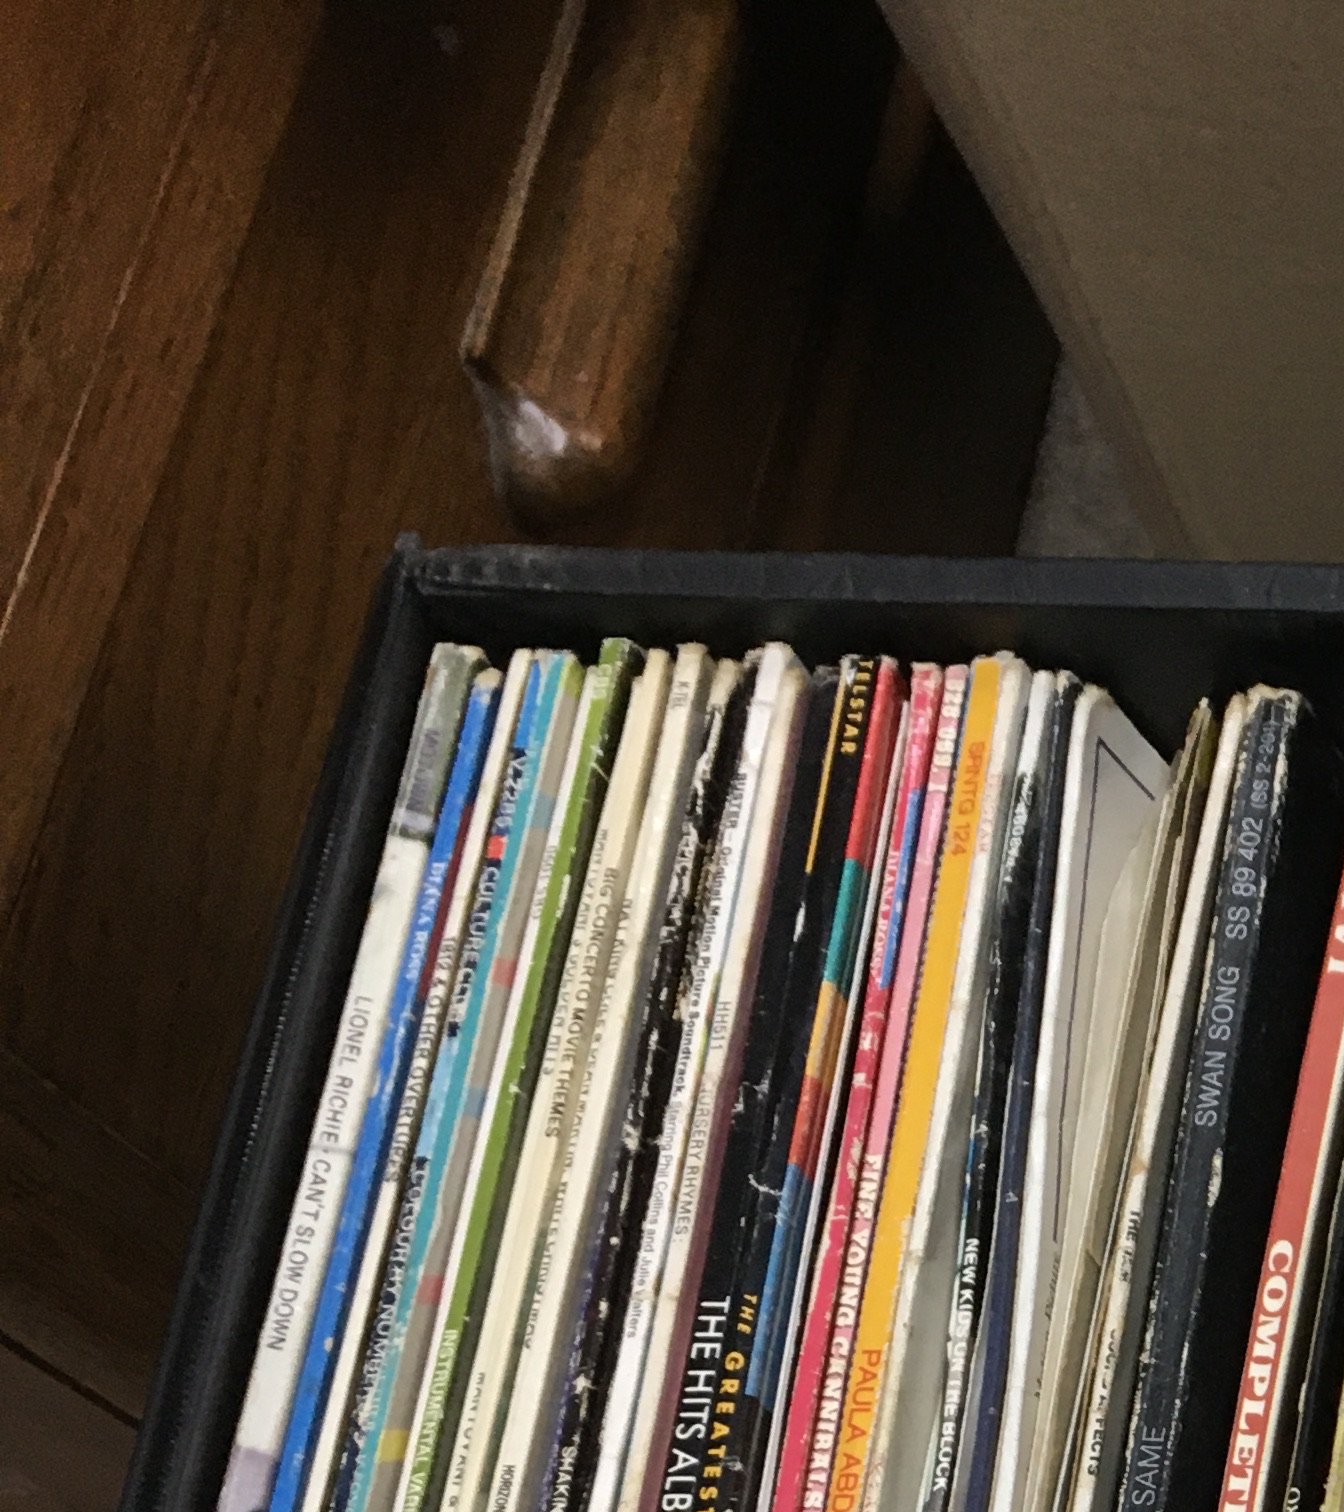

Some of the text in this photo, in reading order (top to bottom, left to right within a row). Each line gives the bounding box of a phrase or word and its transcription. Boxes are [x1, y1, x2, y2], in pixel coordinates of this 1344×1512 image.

[838, 658, 873, 755] TELSTAR
[723, 771, 747, 829] BUSTER
[403, 861, 445, 980] DIANA ROSS
[1222, 816, 1265, 941] SS 89 402
[699, 905, 721, 952] Motion
[543, 867, 618, 1138] BIG CONCERTO MOVIE THEMES
[688, 956, 710, 1007] Picture
[708, 1000, 731, 1051] HH511
[1190, 964, 1242, 1127] SWAN SONG
[265, 995, 373, 1352] LIONEL RICHIE CAN'T SLOW DOWN
[646, 1180, 667, 1224] Collins
[852, 1153, 883, 1219] FINE
[640, 1227, 658, 1252] and
[832, 1228, 870, 1327] YOUNG
[689, 1294, 731, 1360] THE
[735, 1292, 759, 1335] THE
[414, 1328, 459, 1463] INSTRUMENTAL
[673, 1368, 717, 1440] HITS
[843, 1348, 882, 1443] PAULA
[929, 1237, 983, 1492] NEW KIDS ON THE BLOCK
[800, 1336, 852, 1509] CANNIBALS
[1128, 1425, 1168, 1506] SAME
